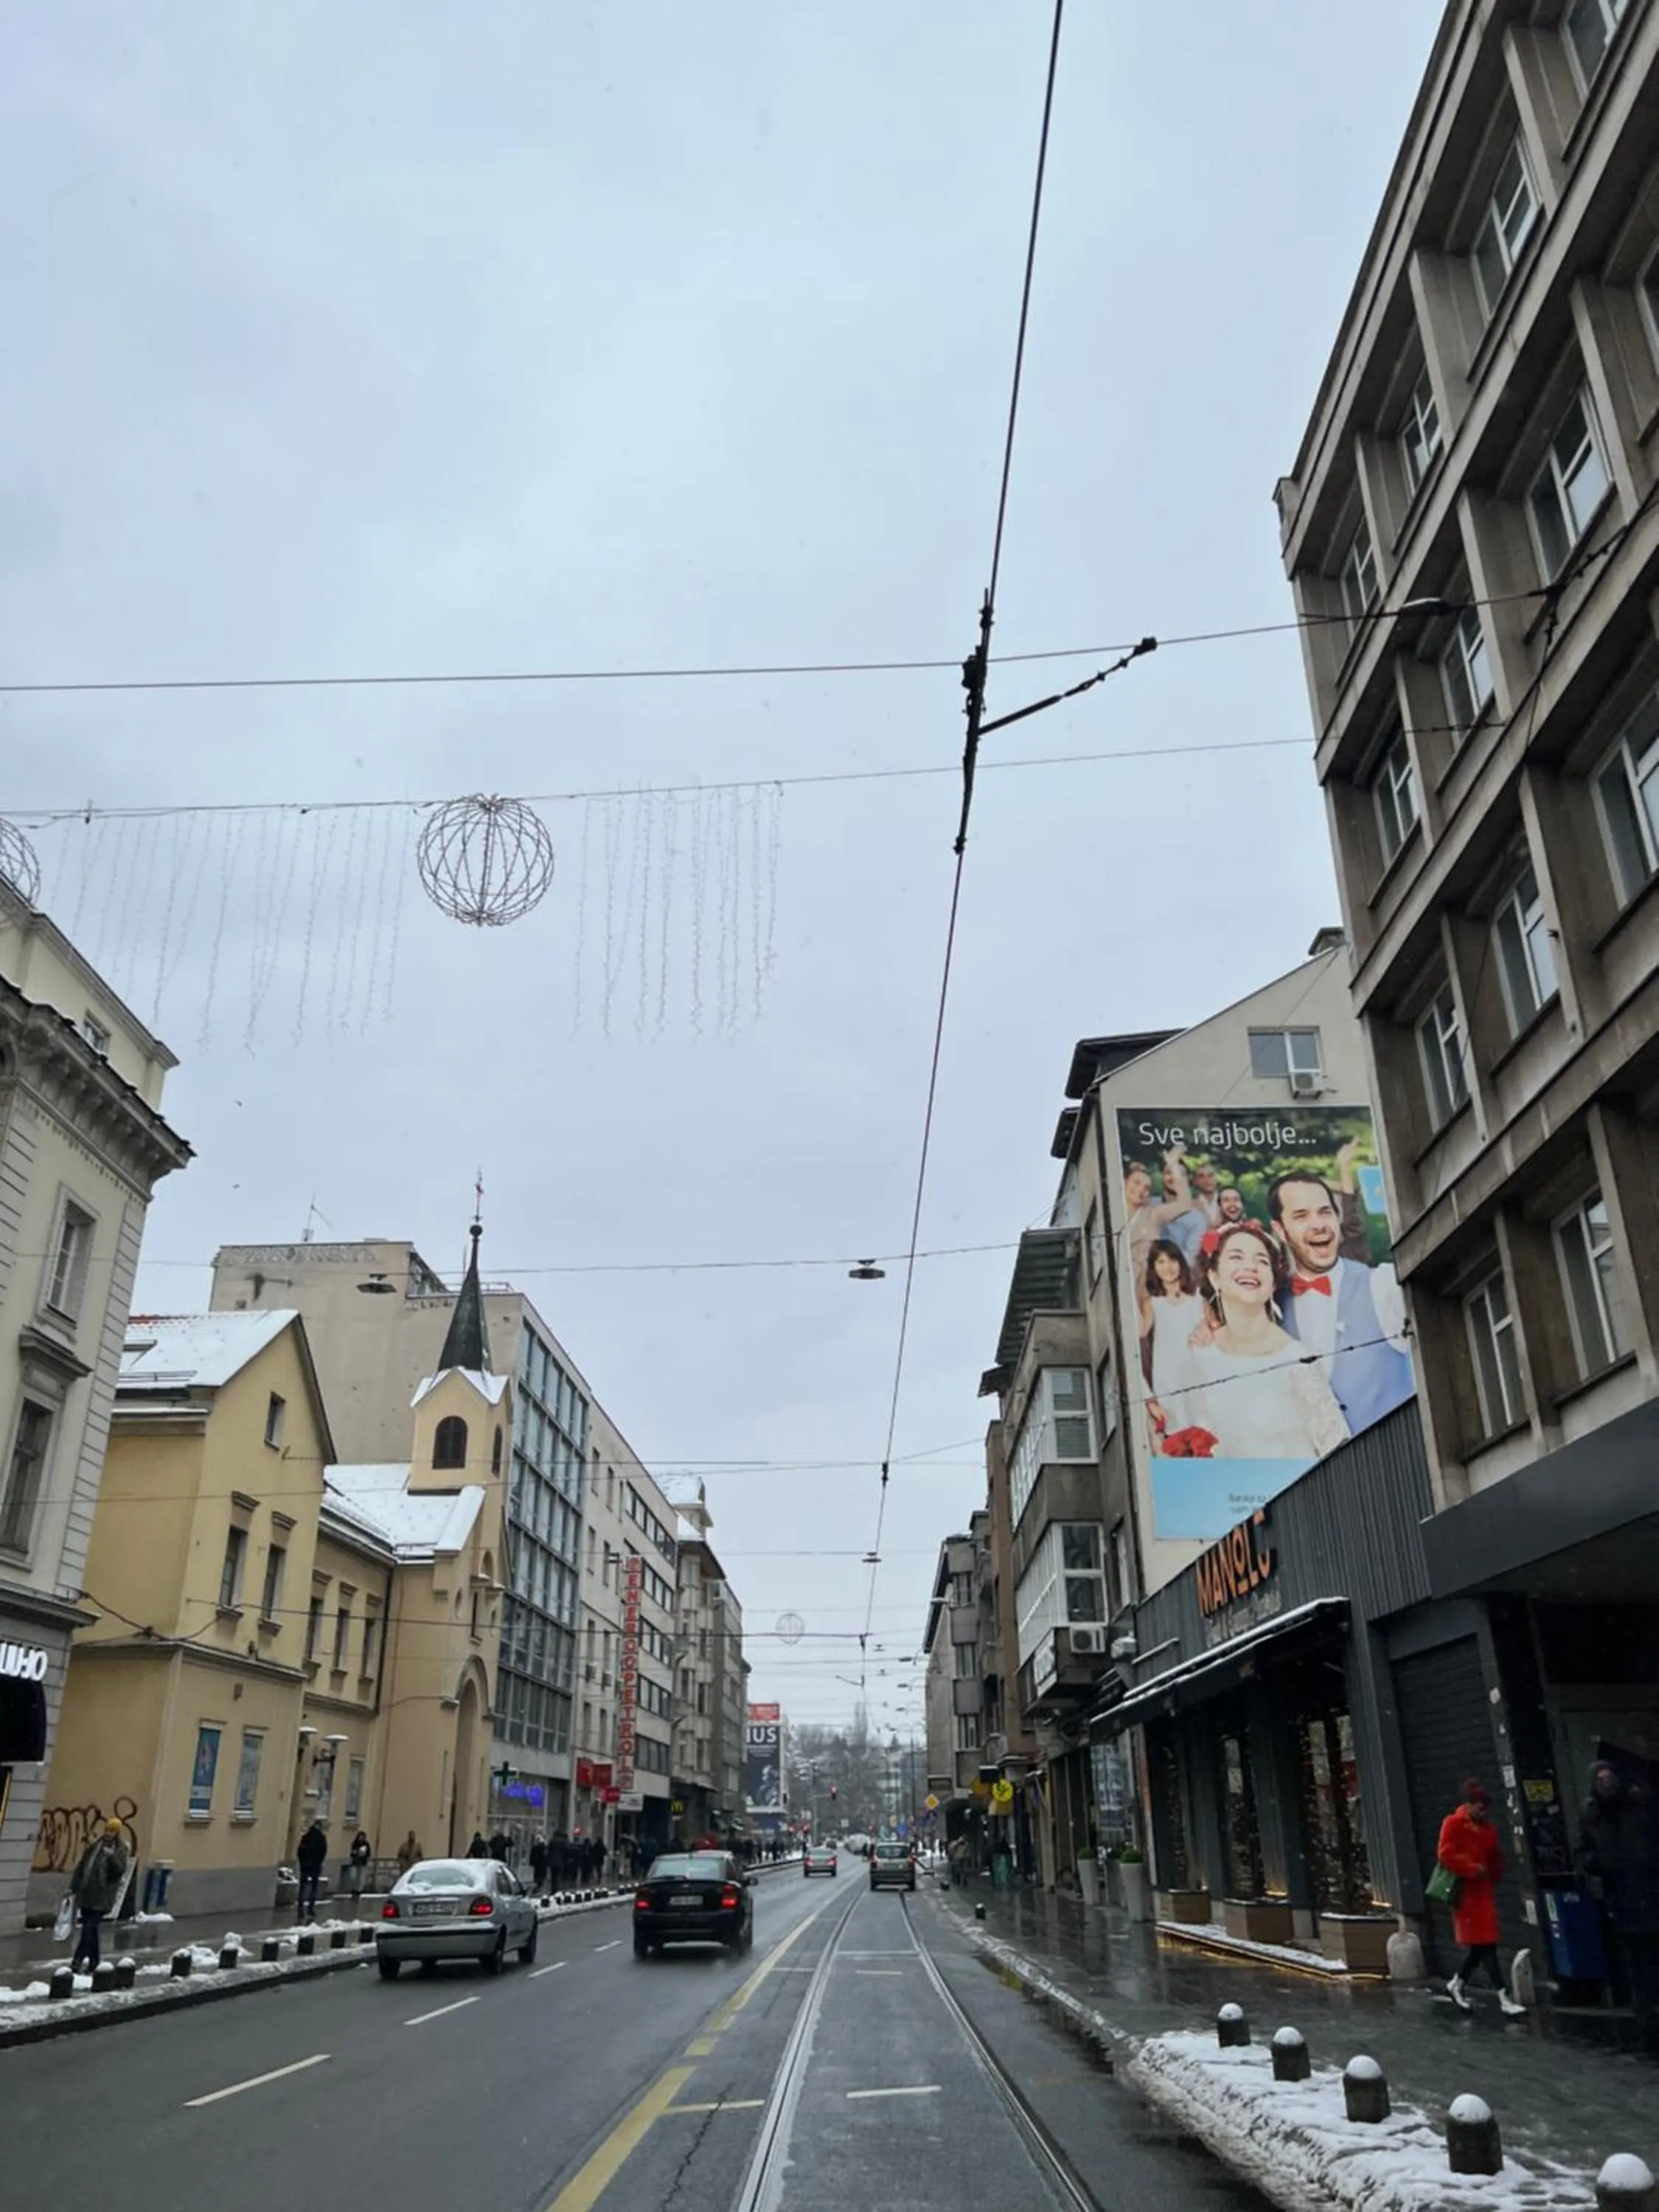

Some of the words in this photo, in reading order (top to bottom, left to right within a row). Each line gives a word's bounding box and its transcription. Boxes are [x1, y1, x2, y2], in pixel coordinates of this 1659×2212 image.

[1138, 1122, 1184, 1145] Sve
[1192, 1121, 1317, 1150] najbolje...
[746, 1727, 777, 1744] IUS
